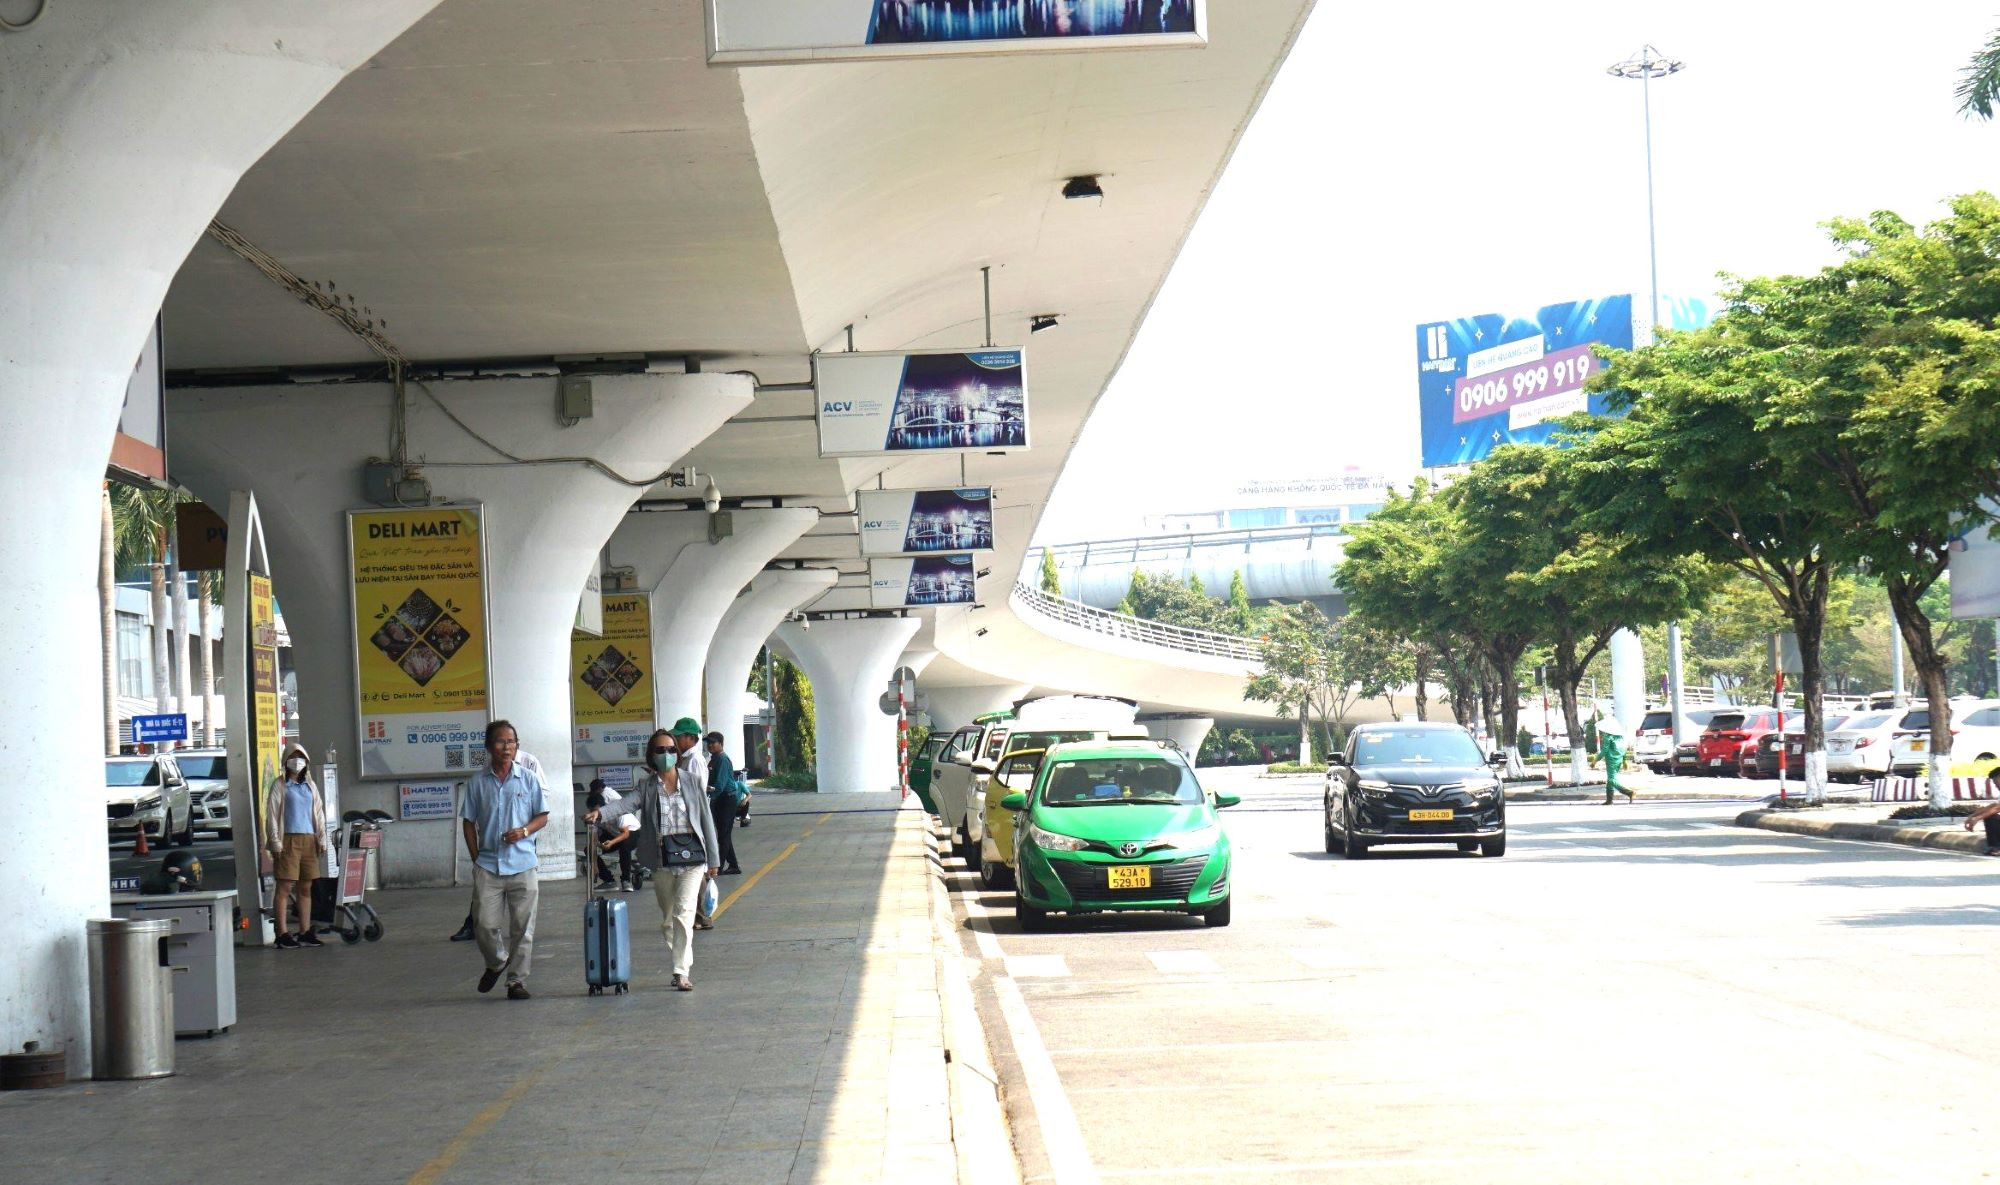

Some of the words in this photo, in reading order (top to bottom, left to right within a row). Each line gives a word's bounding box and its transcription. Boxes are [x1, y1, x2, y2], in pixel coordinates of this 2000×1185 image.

[1460, 378, 1508, 412] 0906
[1513, 366, 1549, 398] 999
[1553, 355, 1590, 387] 919
[823, 401, 852, 412] ACV
[368, 522, 405, 539] DELI
[411, 520, 461, 537] MART
[863, 520, 882, 529] ACV
[605, 601, 638, 613] MART
[421, 733, 447, 743] 0906
[449, 732, 468, 742] 999
[1120, 868, 1138, 877] 43A
[1113, 877, 1146, 888] 529.10
